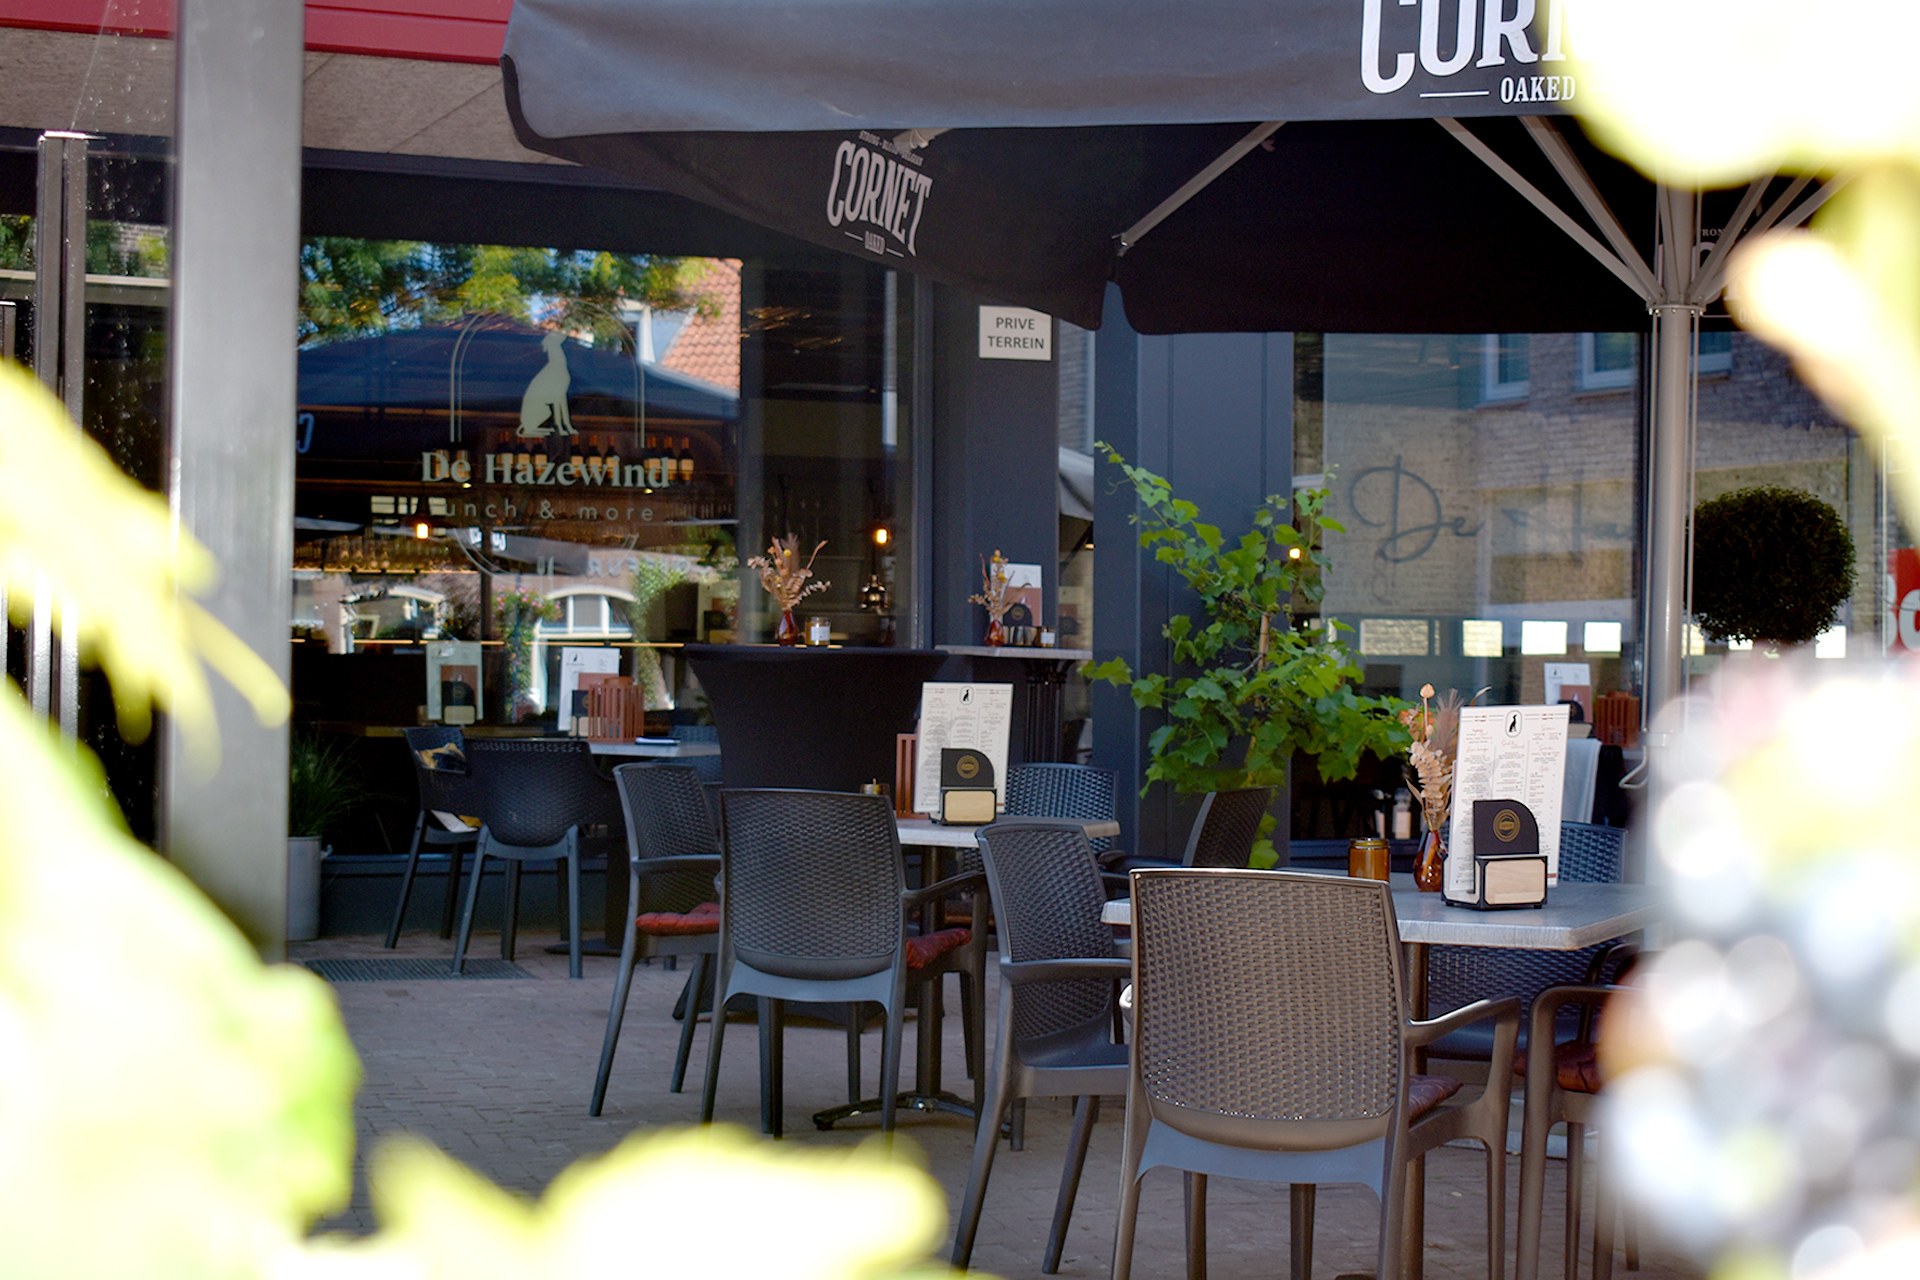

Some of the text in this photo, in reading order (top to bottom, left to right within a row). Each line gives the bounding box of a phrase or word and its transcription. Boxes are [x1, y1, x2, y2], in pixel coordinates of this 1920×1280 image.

[1500, 75, 1576, 103] OAKED
[827, 140, 932, 256] CORNET
[996, 317, 1035, 331] PRIVE
[987, 335, 1045, 350] TERREIN
[421, 451, 671, 489] De Hazewind
[444, 499, 654, 522] unch & more
[1349, 455, 1485, 564] De
